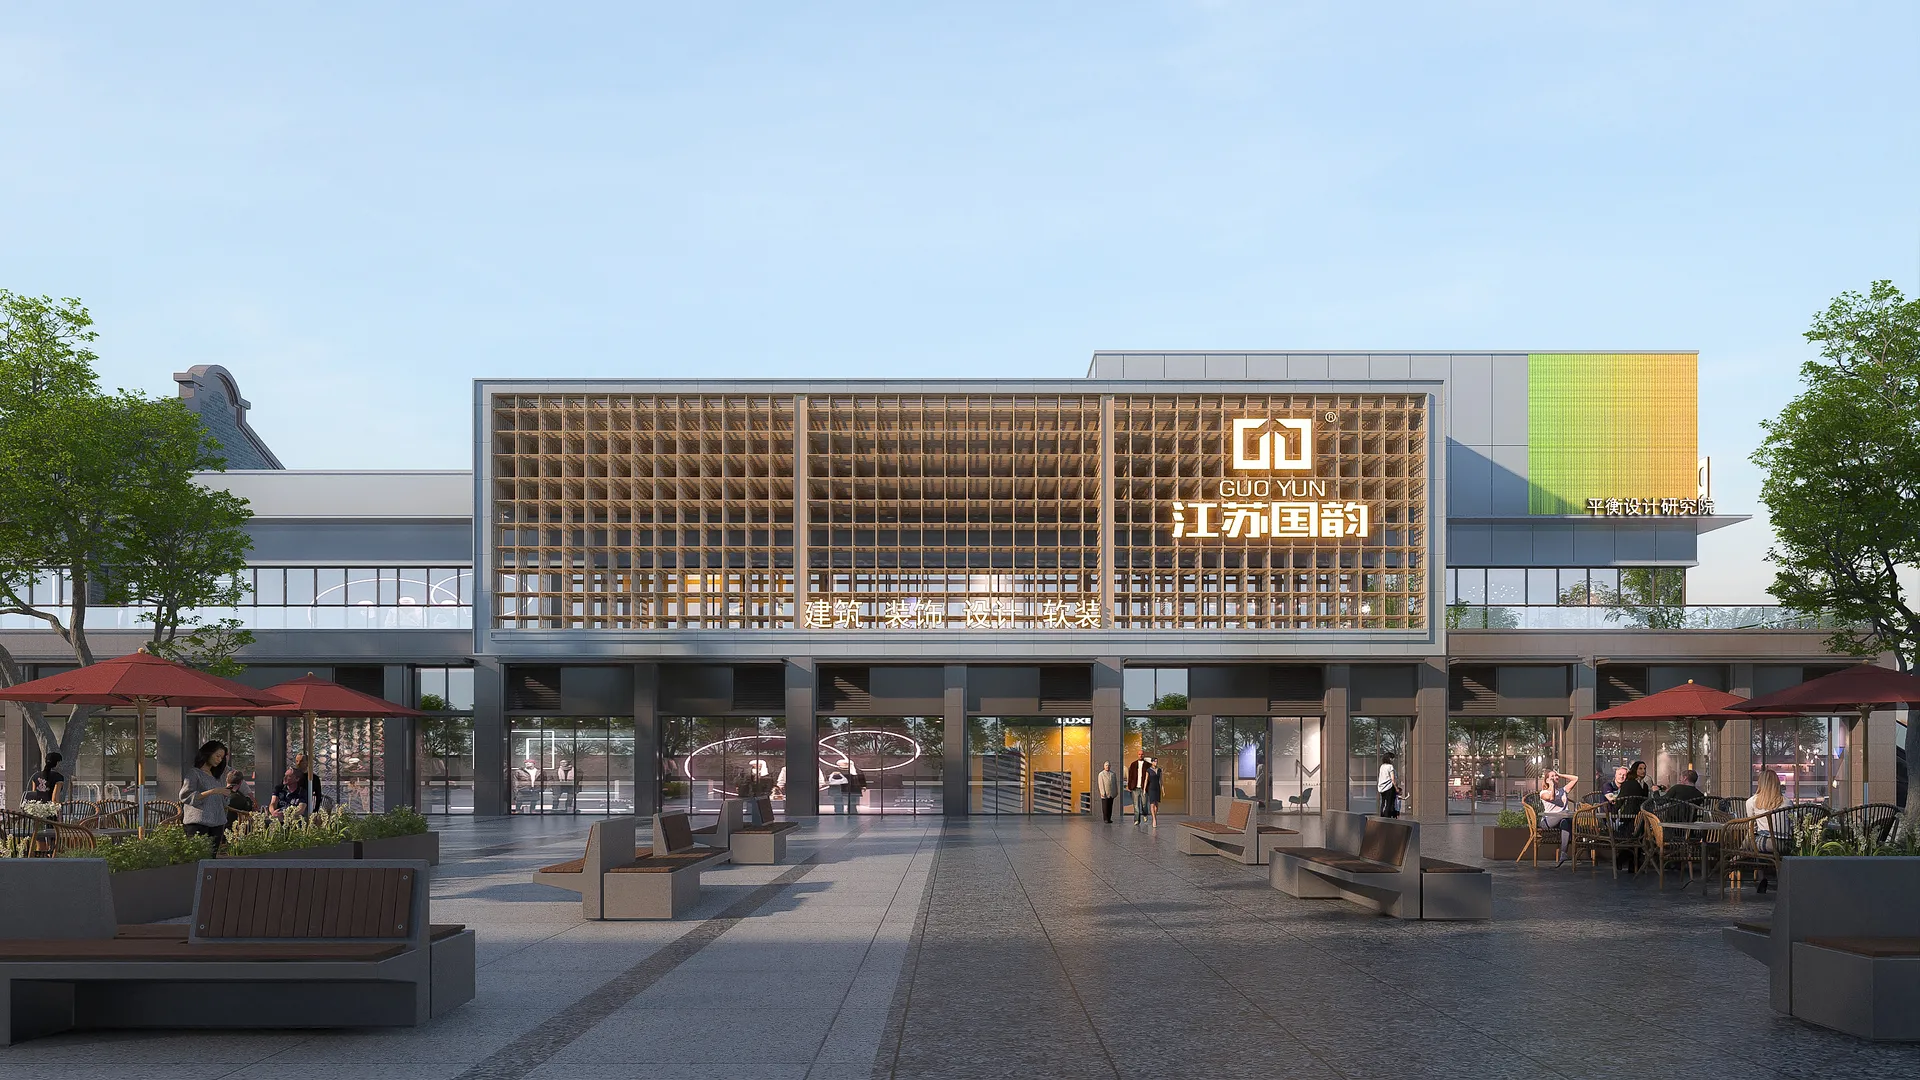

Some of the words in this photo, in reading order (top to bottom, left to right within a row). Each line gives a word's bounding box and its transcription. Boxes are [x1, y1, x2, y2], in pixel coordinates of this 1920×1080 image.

[1219, 480, 1270, 497] GUO
[1276, 480, 1326, 497] YUN
[1586, 497, 1716, 516] 平衡设计研究院
[1172, 501, 1369, 538] 江苏国韵
[804, 599, 864, 629] 建筑
[884, 599, 944, 629] 装饰
[962, 599, 1023, 629] 设计
[1042, 599, 1102, 629] 软装
